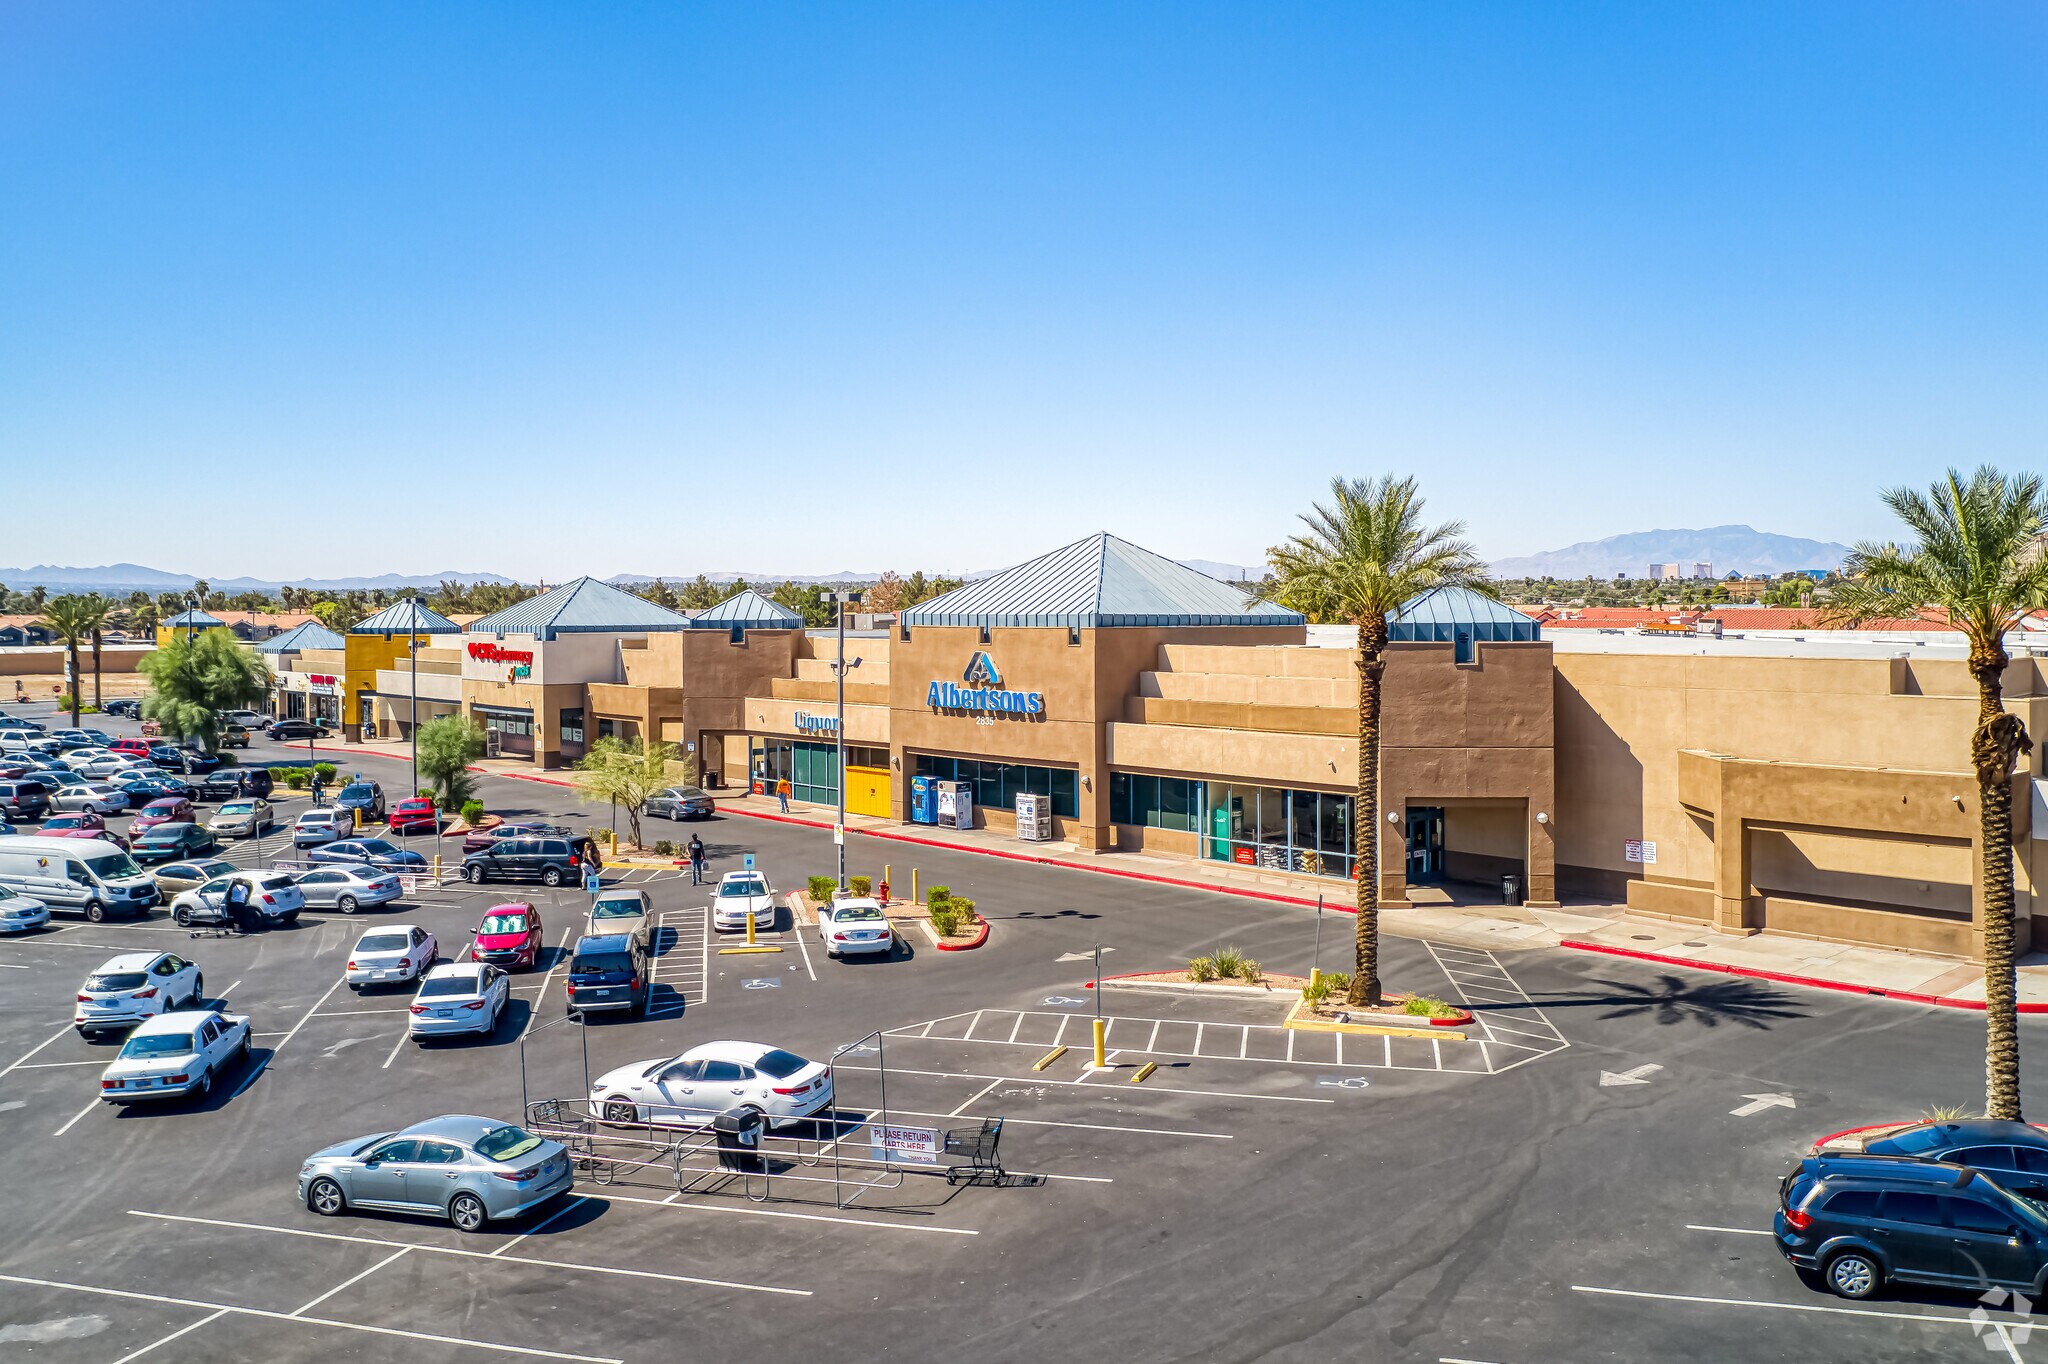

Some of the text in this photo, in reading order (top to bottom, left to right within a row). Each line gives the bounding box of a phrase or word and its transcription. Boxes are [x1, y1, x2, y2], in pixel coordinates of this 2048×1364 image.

[927, 680, 1041, 714] Albertsons
[976, 715, 994, 726] 2835
[903, 1131, 932, 1142] RETURN
